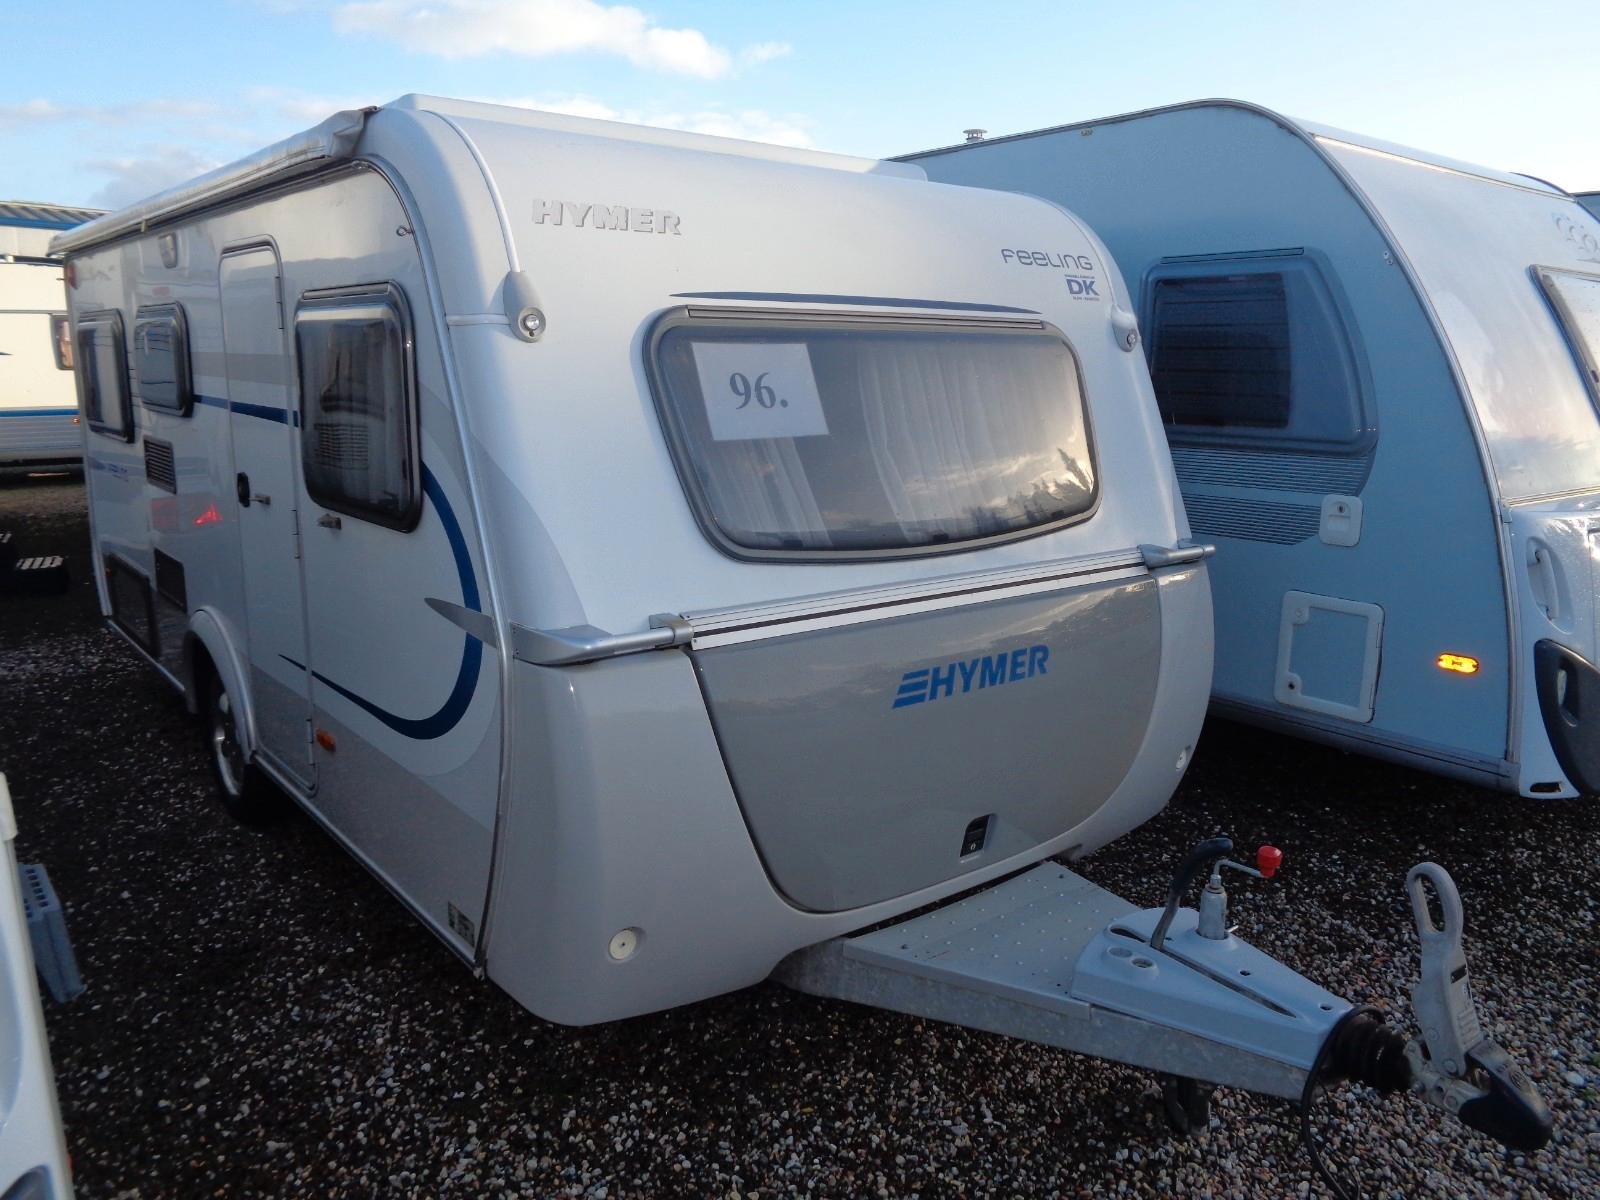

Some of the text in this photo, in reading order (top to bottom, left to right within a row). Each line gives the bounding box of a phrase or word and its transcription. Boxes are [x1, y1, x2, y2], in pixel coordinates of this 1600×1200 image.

[532, 198, 682, 236] HYMER
[1066, 278, 1100, 297] DK
[729, 371, 788, 410] 96.
[928, 644, 1050, 701] HYMER
